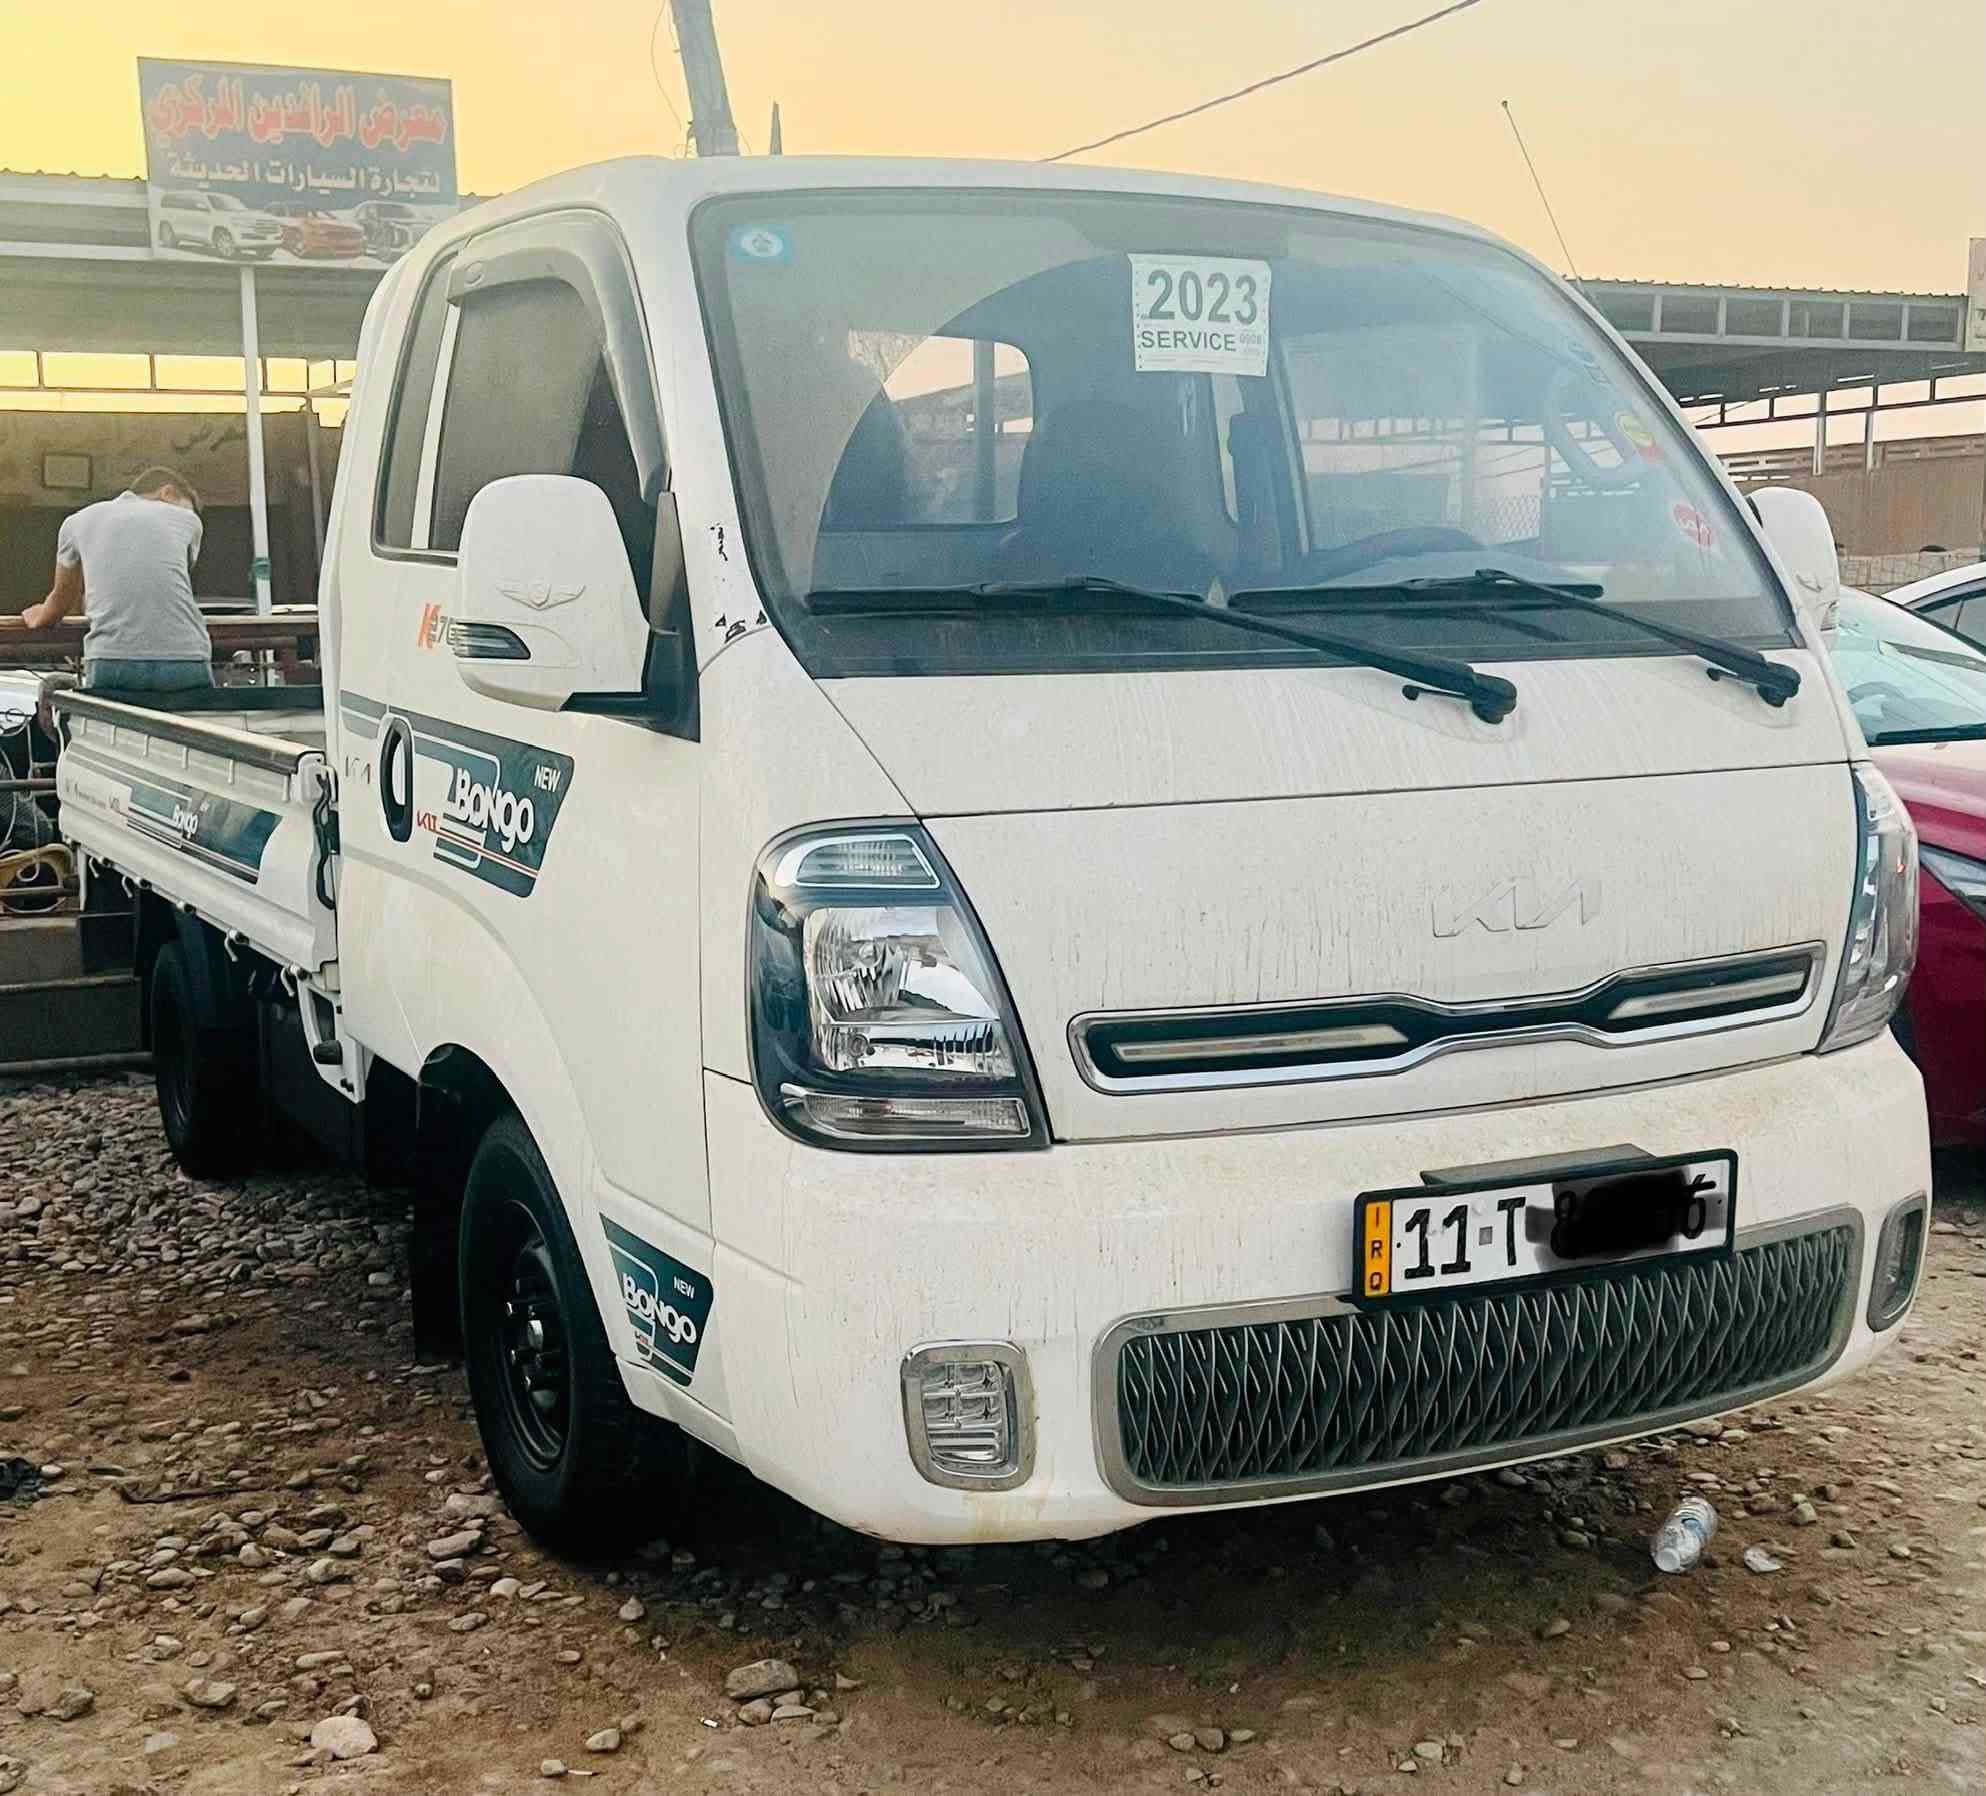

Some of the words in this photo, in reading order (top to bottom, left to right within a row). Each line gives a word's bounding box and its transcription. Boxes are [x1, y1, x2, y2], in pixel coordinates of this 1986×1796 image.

[358, 87, 449, 152] معرض
[168, 150, 261, 189] الحديثة
[266, 160, 366, 195] السيارات
[368, 165, 441, 198] لتجارة
[1147, 269, 1258, 326] 2023
[1140, 330, 1237, 352] SERVICE
[533, 764, 561, 792] NEW
[1367, 1205, 1385, 1290] IRQ
[673, 1275, 695, 1300] NEW
